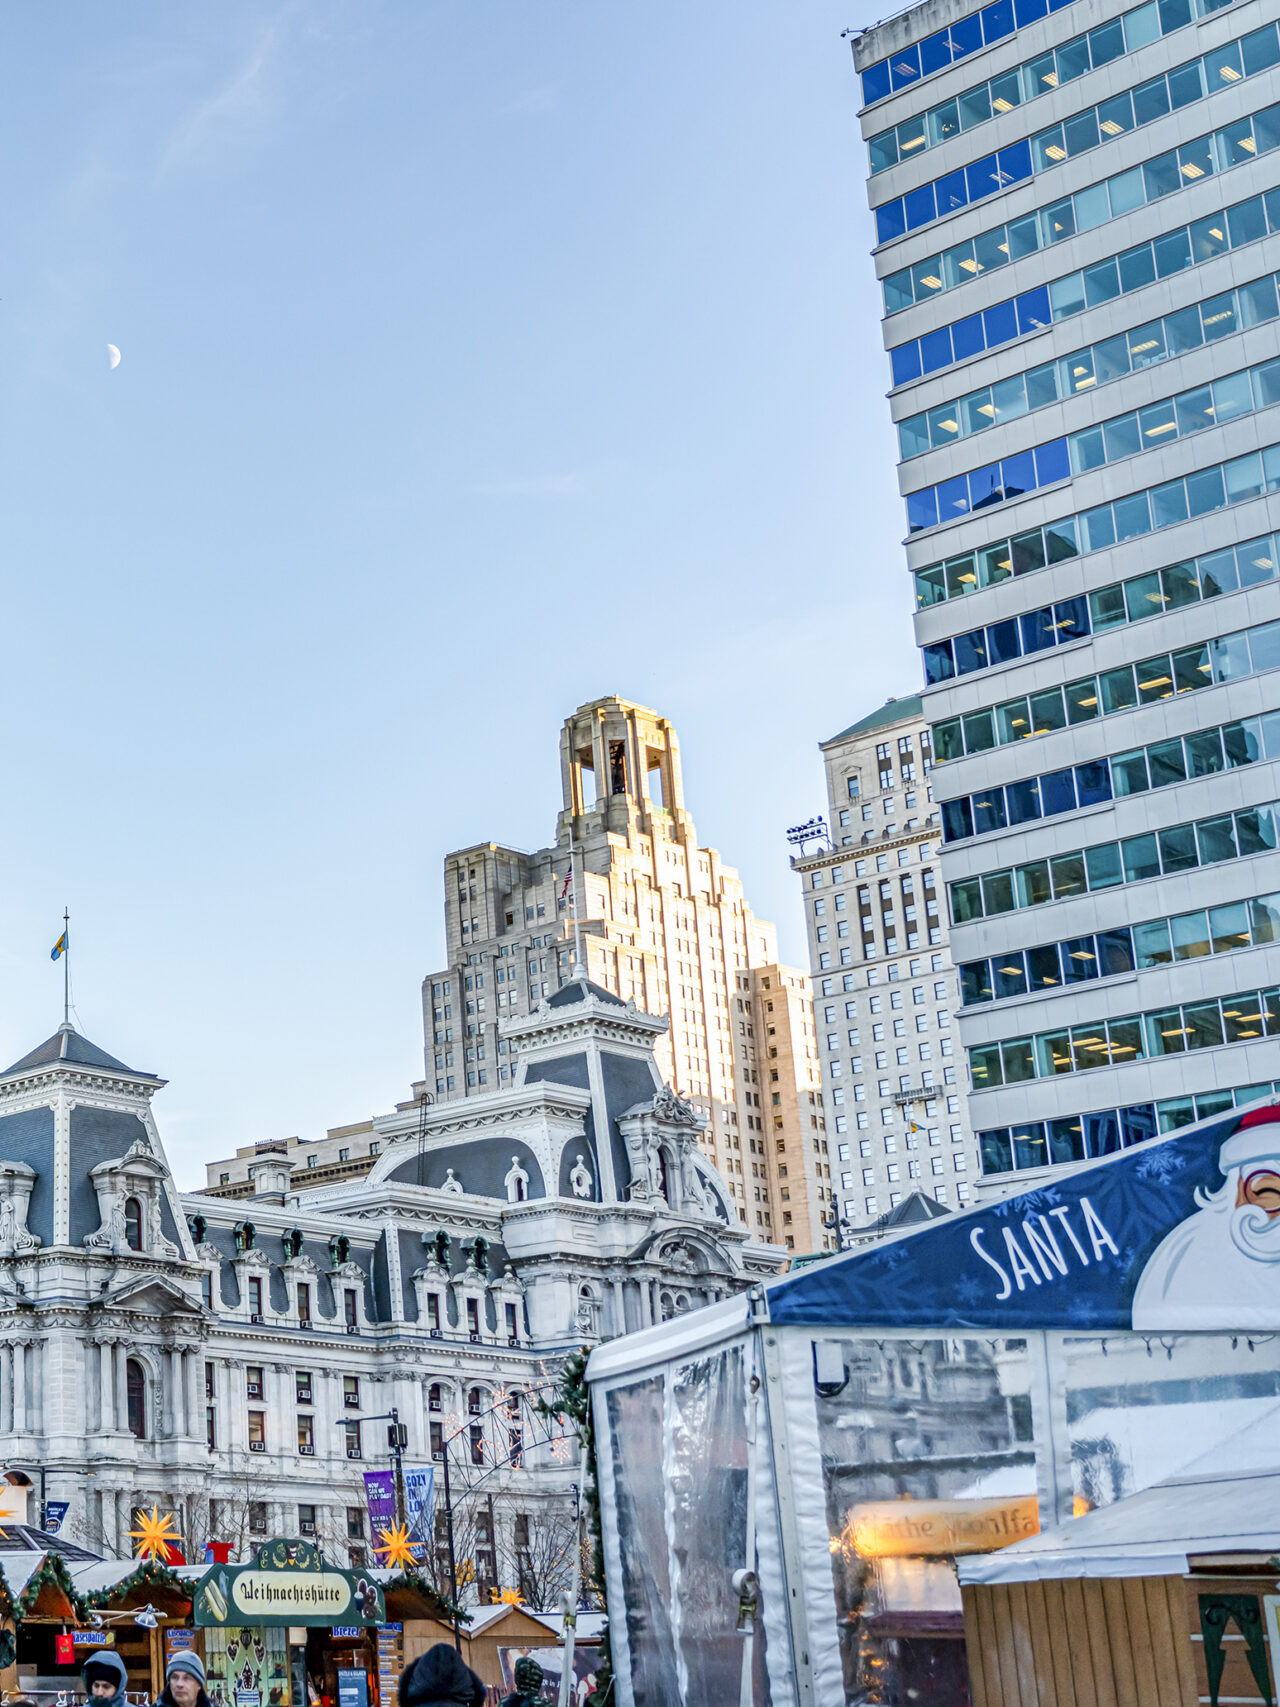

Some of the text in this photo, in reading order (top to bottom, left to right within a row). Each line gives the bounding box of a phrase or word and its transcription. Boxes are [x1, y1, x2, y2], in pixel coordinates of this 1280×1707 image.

[970, 1197, 1119, 1300] SANTA
[406, 1474, 426, 1487] COZY
[408, 1487, 417, 1500] IN
[240, 1579, 340, 1606] Weihnachtshütte
